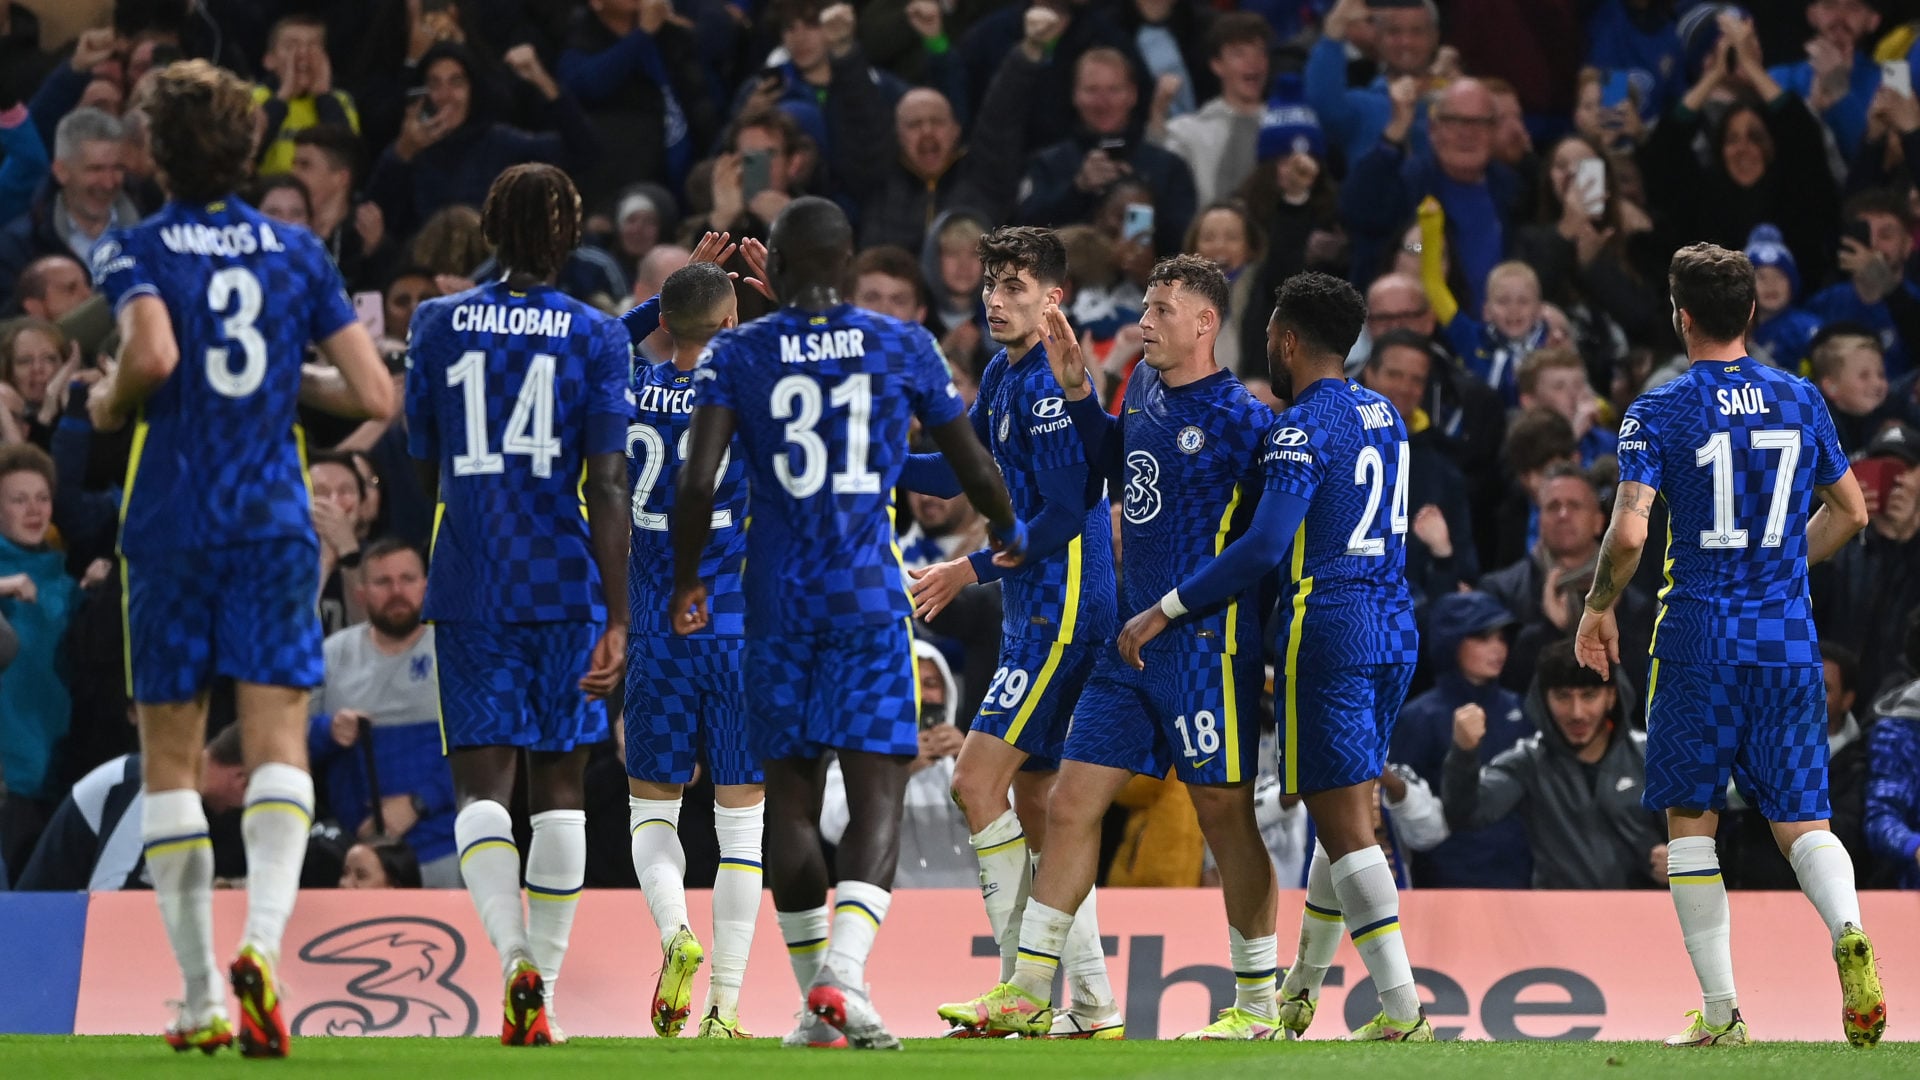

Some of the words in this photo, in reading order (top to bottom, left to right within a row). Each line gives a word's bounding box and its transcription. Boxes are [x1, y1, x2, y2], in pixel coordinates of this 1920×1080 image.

[206, 266, 268, 397] 3
[452, 304, 571, 338] CHALOBAH
[446, 351, 561, 479] 14
[640, 385, 696, 414] ZIYEC
[1355, 401, 1394, 431] JAMES
[1716, 382, 1770, 416] SAÚL
[770, 373, 881, 499] 31
[1264, 450, 1313, 464] HYUNDAI
[1344, 441, 1411, 556] 24
[1696, 429, 1801, 549] 17
[983, 667, 1028, 709] 29
[1174, 710, 1220, 758] 18
